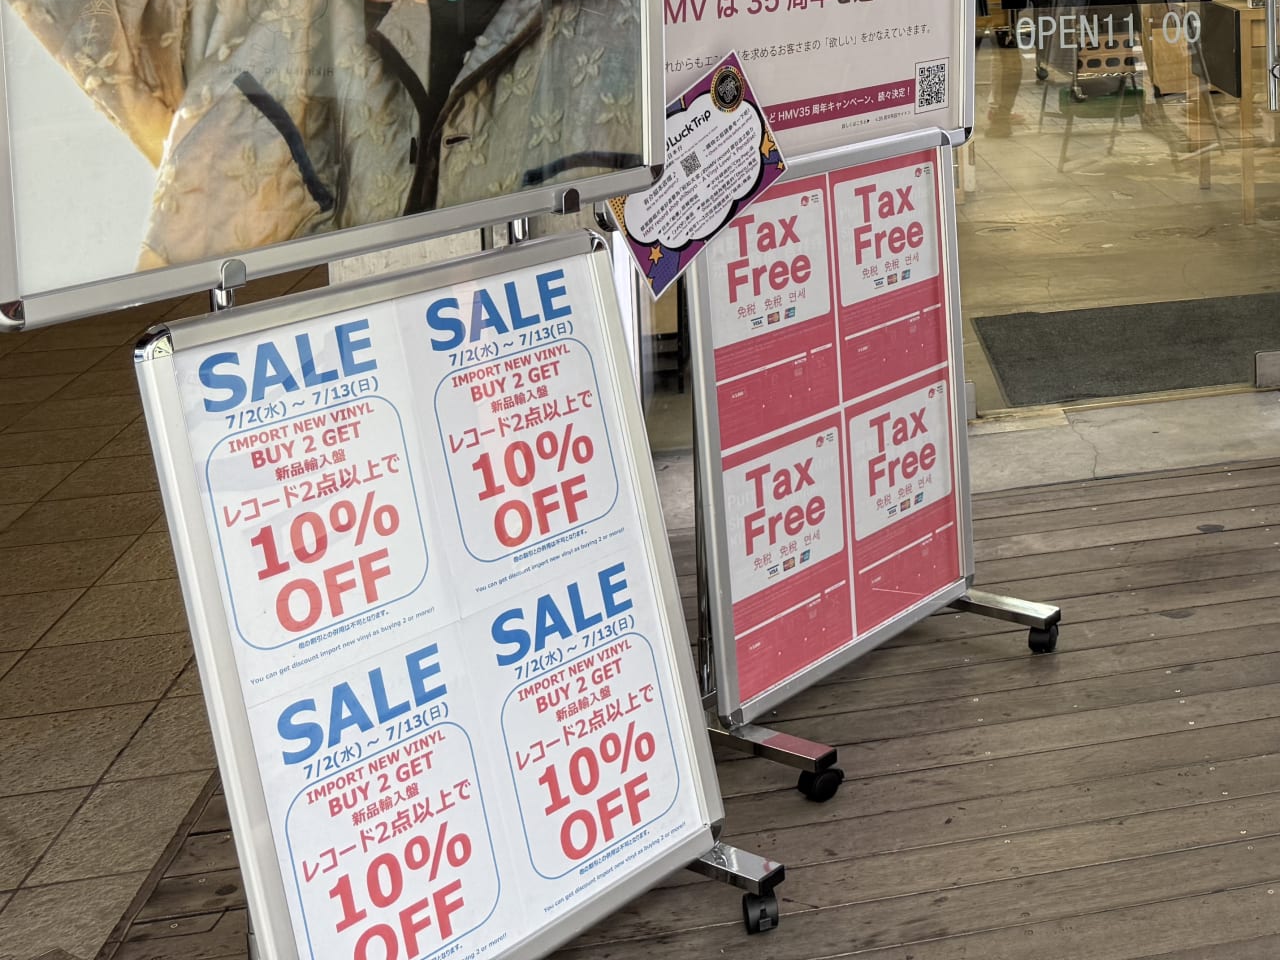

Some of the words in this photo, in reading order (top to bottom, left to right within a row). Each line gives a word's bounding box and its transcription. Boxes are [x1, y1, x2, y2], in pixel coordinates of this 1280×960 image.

[854, 184, 915, 223] Tax
[729, 215, 800, 258] Tax
[854, 221, 924, 265] Free
[426, 269, 572, 351] SALE
[728, 255, 811, 303] Free
[199, 319, 378, 412] SALE
[229, 425, 288, 453] IMPORT
[293, 415, 326, 435] NEW
[330, 402, 374, 423] VINYL
[251, 440, 295, 469] BUY
[303, 436, 316, 453] 2
[323, 421, 361, 446] GET
[223, 453, 400, 527] レコード2点以上で
[275, 448, 346, 481] 新品輸入盤
[472, 424, 594, 500] 10%
[745, 457, 815, 509] Tax
[251, 491, 399, 580] 10%
[494, 475, 589, 547] OFF
[744, 495, 826, 557] Free
[276, 548, 391, 632] OFF
[491, 562, 633, 666] SALE
[250, 676, 264, 685] You
[265, 671, 278, 680] can
[279, 664, 290, 675] get
[292, 653, 319, 669] discount
[320, 645, 341, 658] import
[342, 639, 356, 648] new
[357, 632, 371, 643] vinyl
[381, 621, 401, 633] buying
[277, 643, 447, 765] SALE
